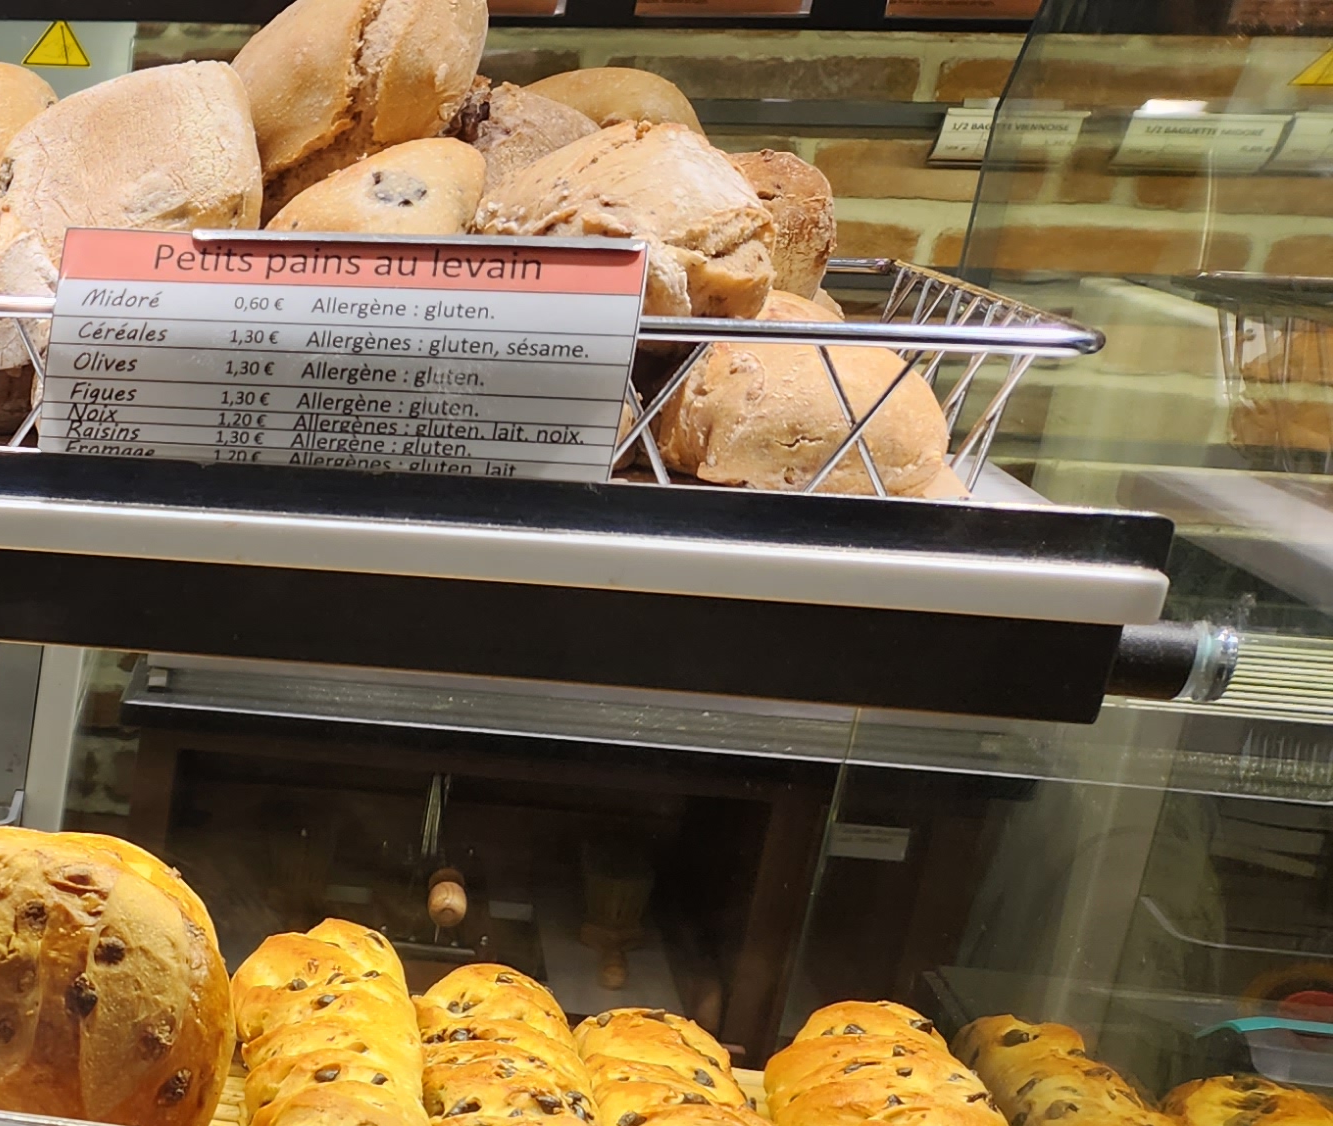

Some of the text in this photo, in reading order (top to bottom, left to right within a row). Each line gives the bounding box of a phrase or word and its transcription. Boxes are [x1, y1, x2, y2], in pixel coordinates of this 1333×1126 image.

[154, 243, 543, 281] Petits pains au levain
[82, 288, 495, 321] Midoré 0,60 € Allergène gluten.
[78, 321, 589, 359] Céréales 1,30 € Allergènes gluten, sésame.
[73, 352, 484, 388] Olives 1,30 € Allergène gluten.
[66, 403, 118, 422] Noix
[218, 412, 252, 428] 1,20
[256, 413, 267, 428] €
[293, 414, 397, 435] Allergènes
[70, 382, 479, 419] Figues 1,30 € Allergène gluten.
[66, 420, 471, 457] Raisins 1,30 € Allergène gluten.
